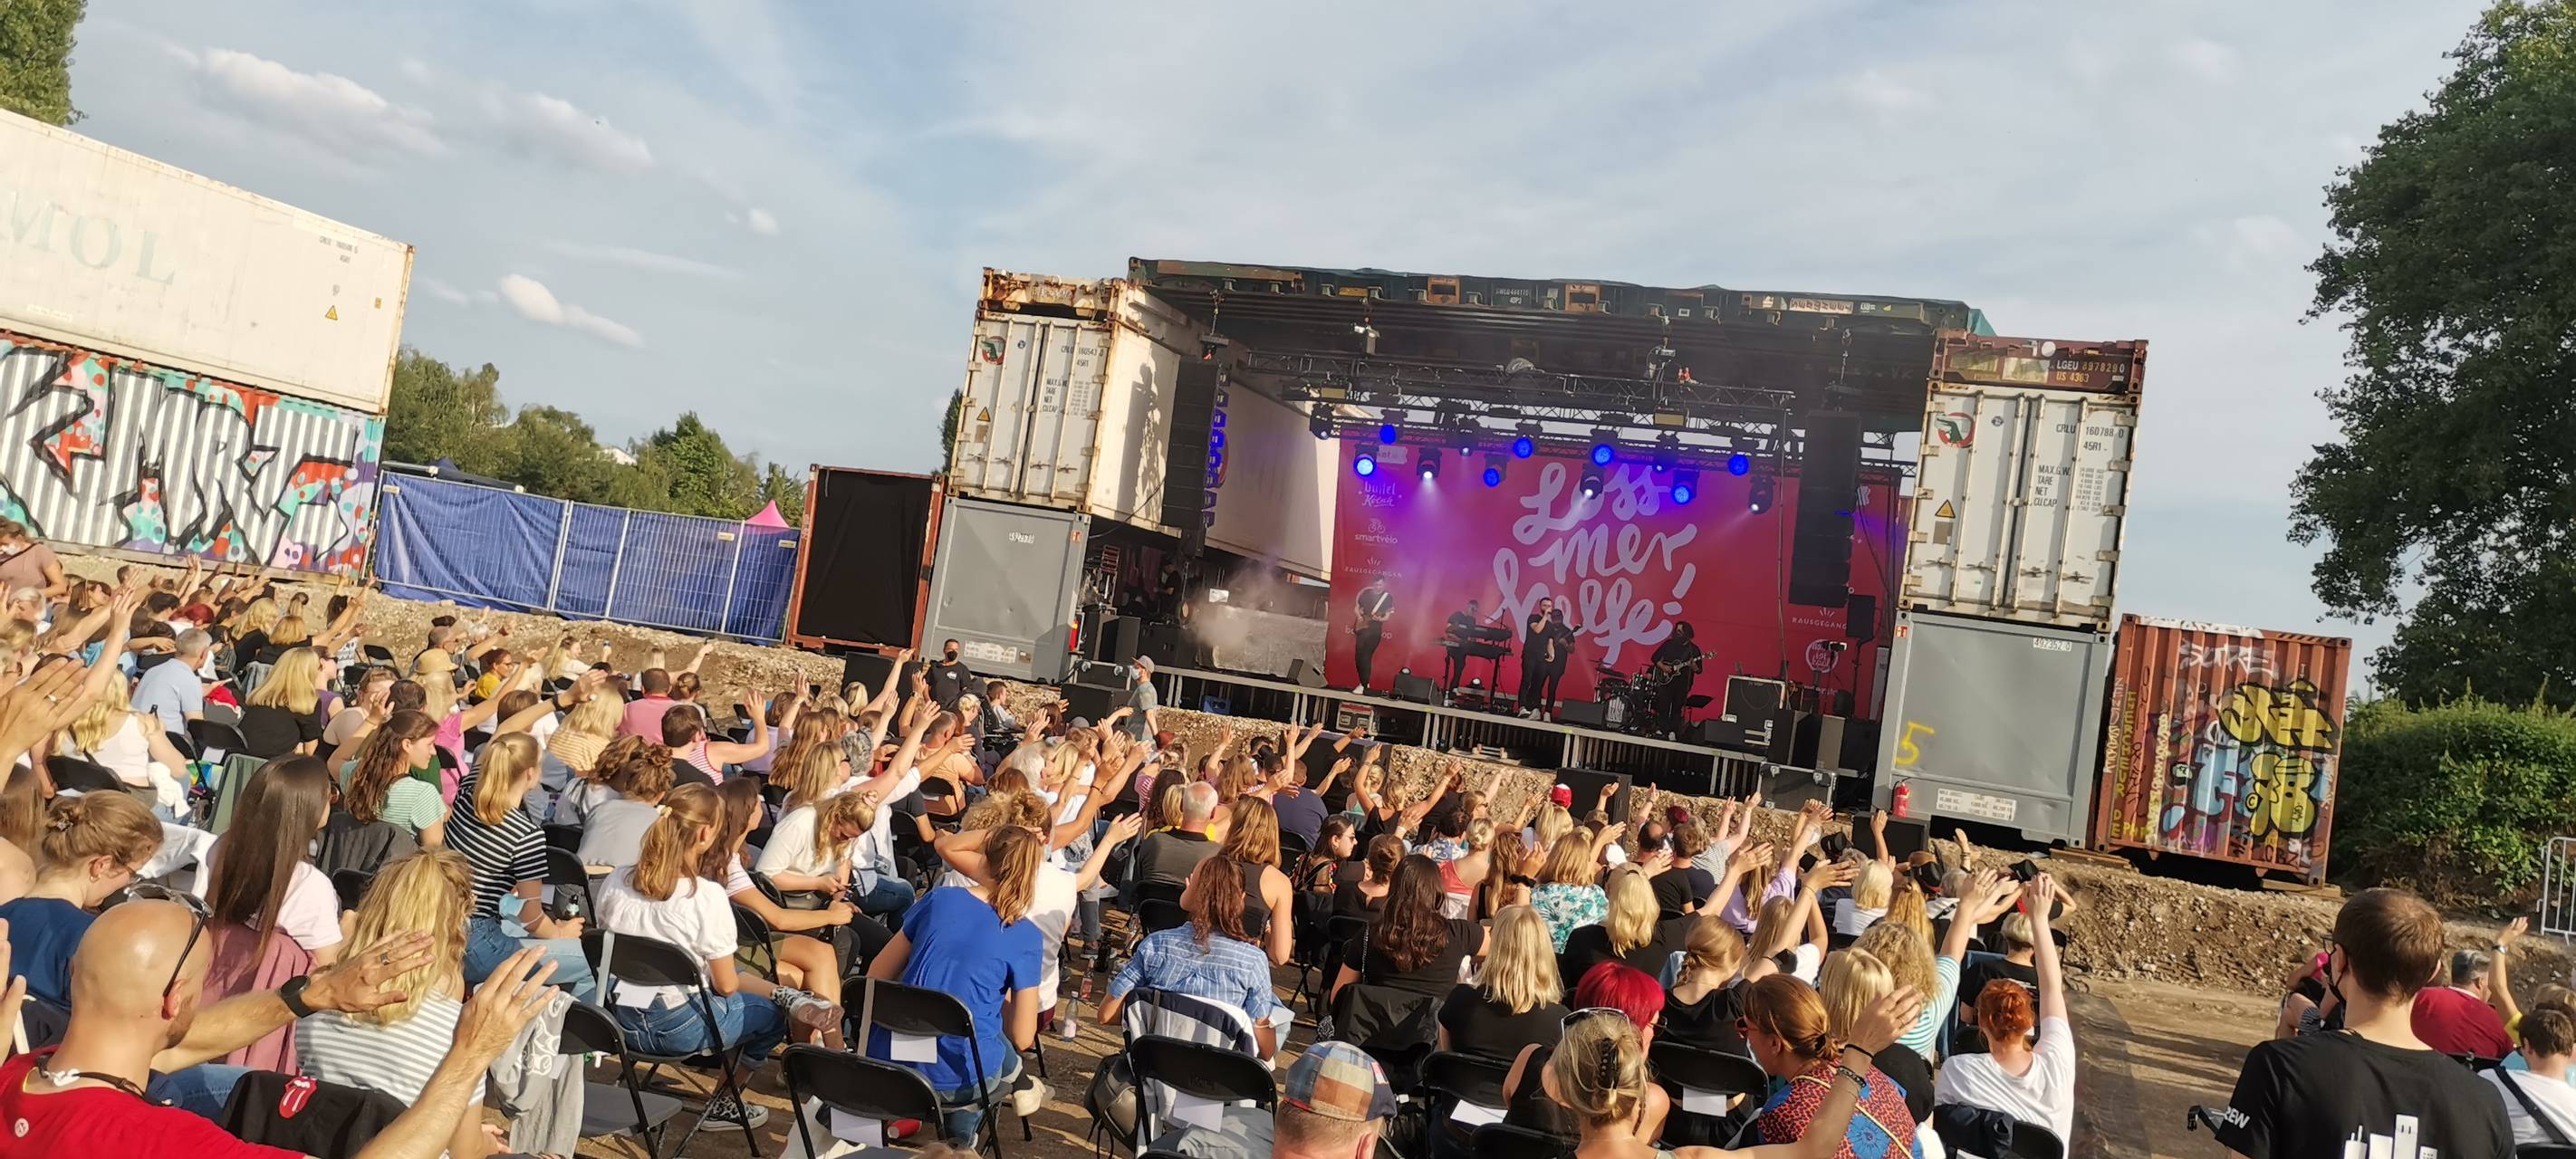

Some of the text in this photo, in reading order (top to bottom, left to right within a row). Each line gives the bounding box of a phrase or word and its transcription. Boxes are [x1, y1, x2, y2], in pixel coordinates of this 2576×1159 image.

[2056, 359, 2079, 370] LGEU
[2056, 371, 2066, 381] US
[2056, 424, 2076, 434] CRLU
[2086, 426, 2114, 436] 160788
[2083, 442, 2101, 451] 45R1
[2037, 475, 2053, 485] TARE
[2034, 486, 2048, 495] NET
[1528, 523, 1697, 584] mer
[1896, 721, 1936, 764] 5
